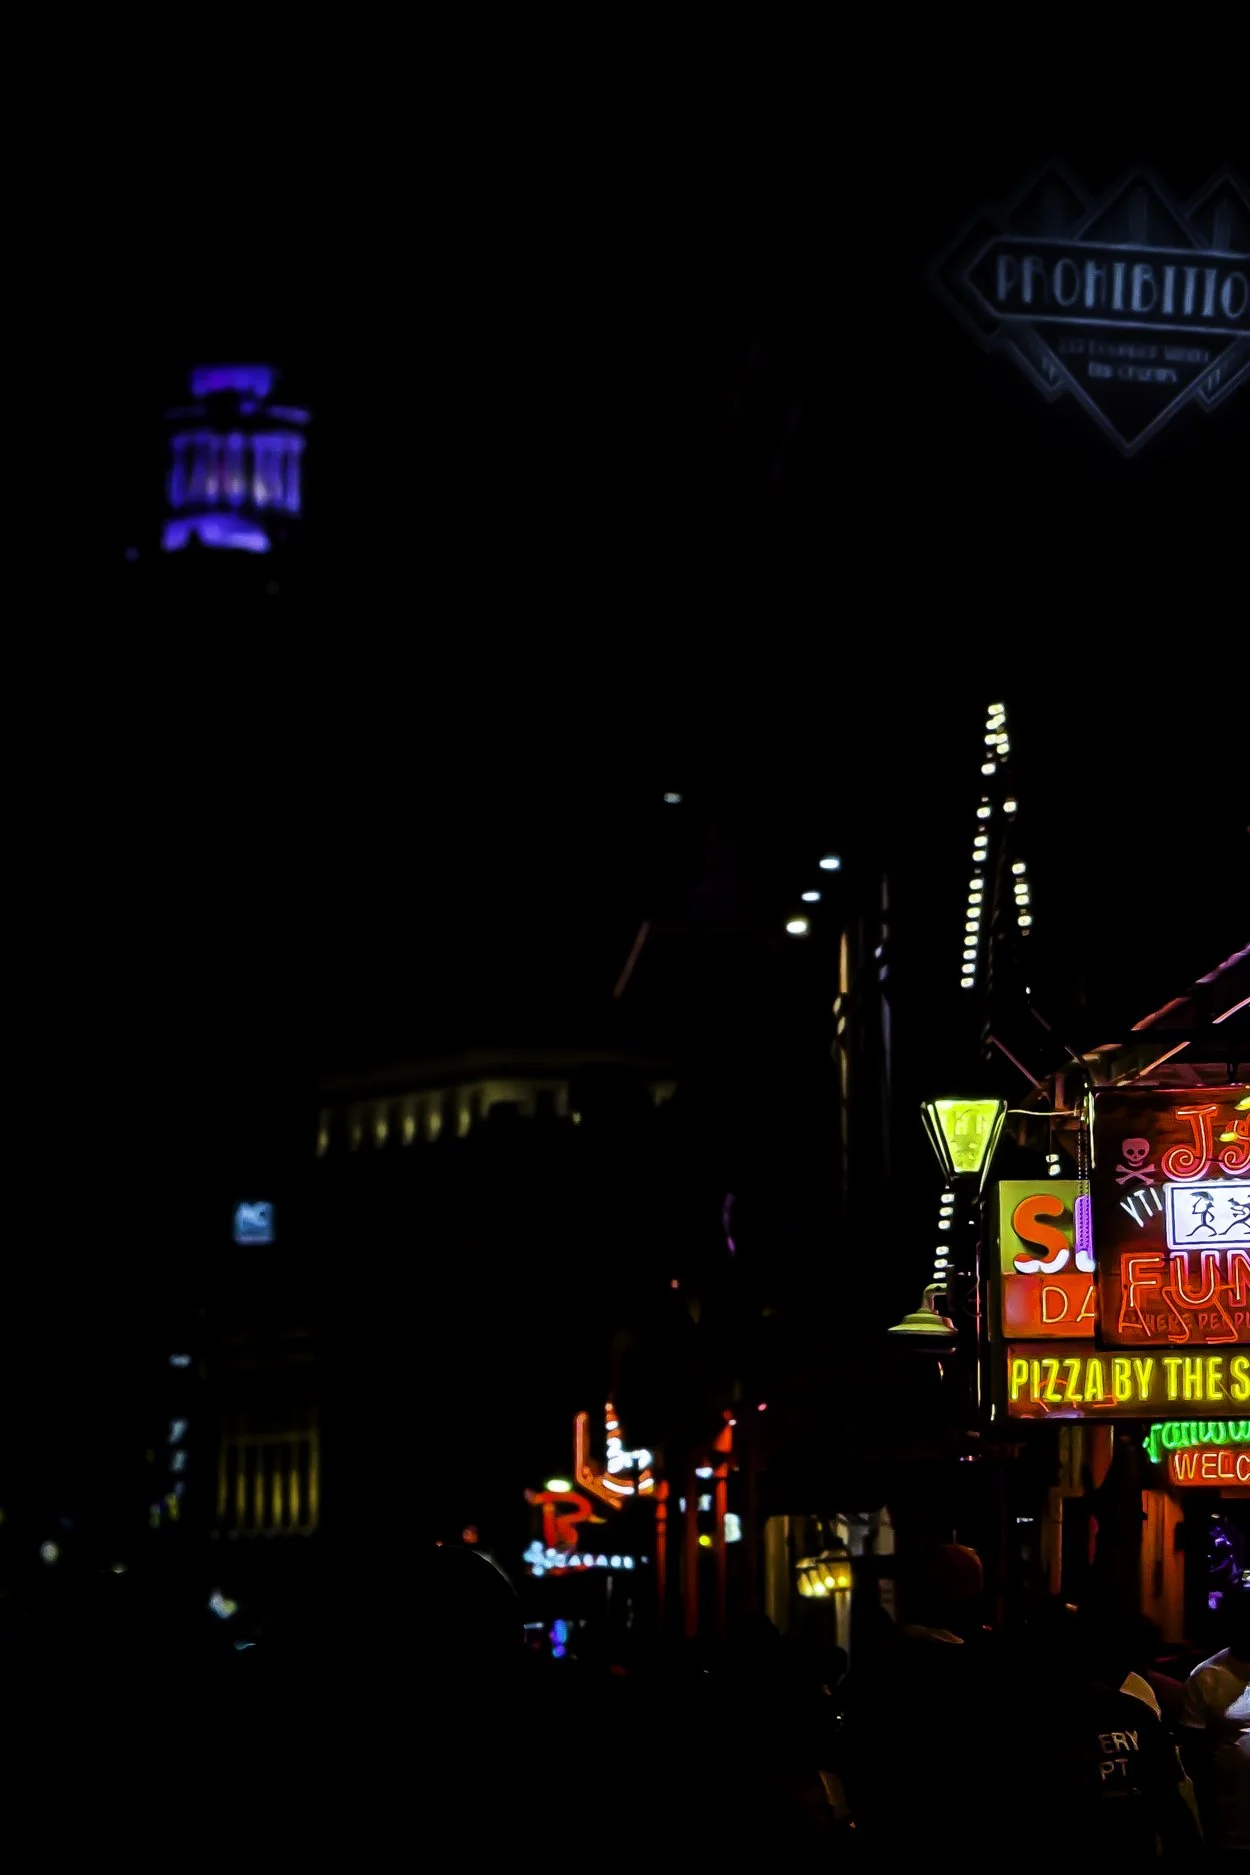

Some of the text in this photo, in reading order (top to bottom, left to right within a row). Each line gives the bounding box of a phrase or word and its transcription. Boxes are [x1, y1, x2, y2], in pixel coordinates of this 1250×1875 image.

[1009, 1357, 1105, 1403] PIZZA
[1112, 1356, 1153, 1402] BY
[1162, 1356, 1223, 1402] THE
